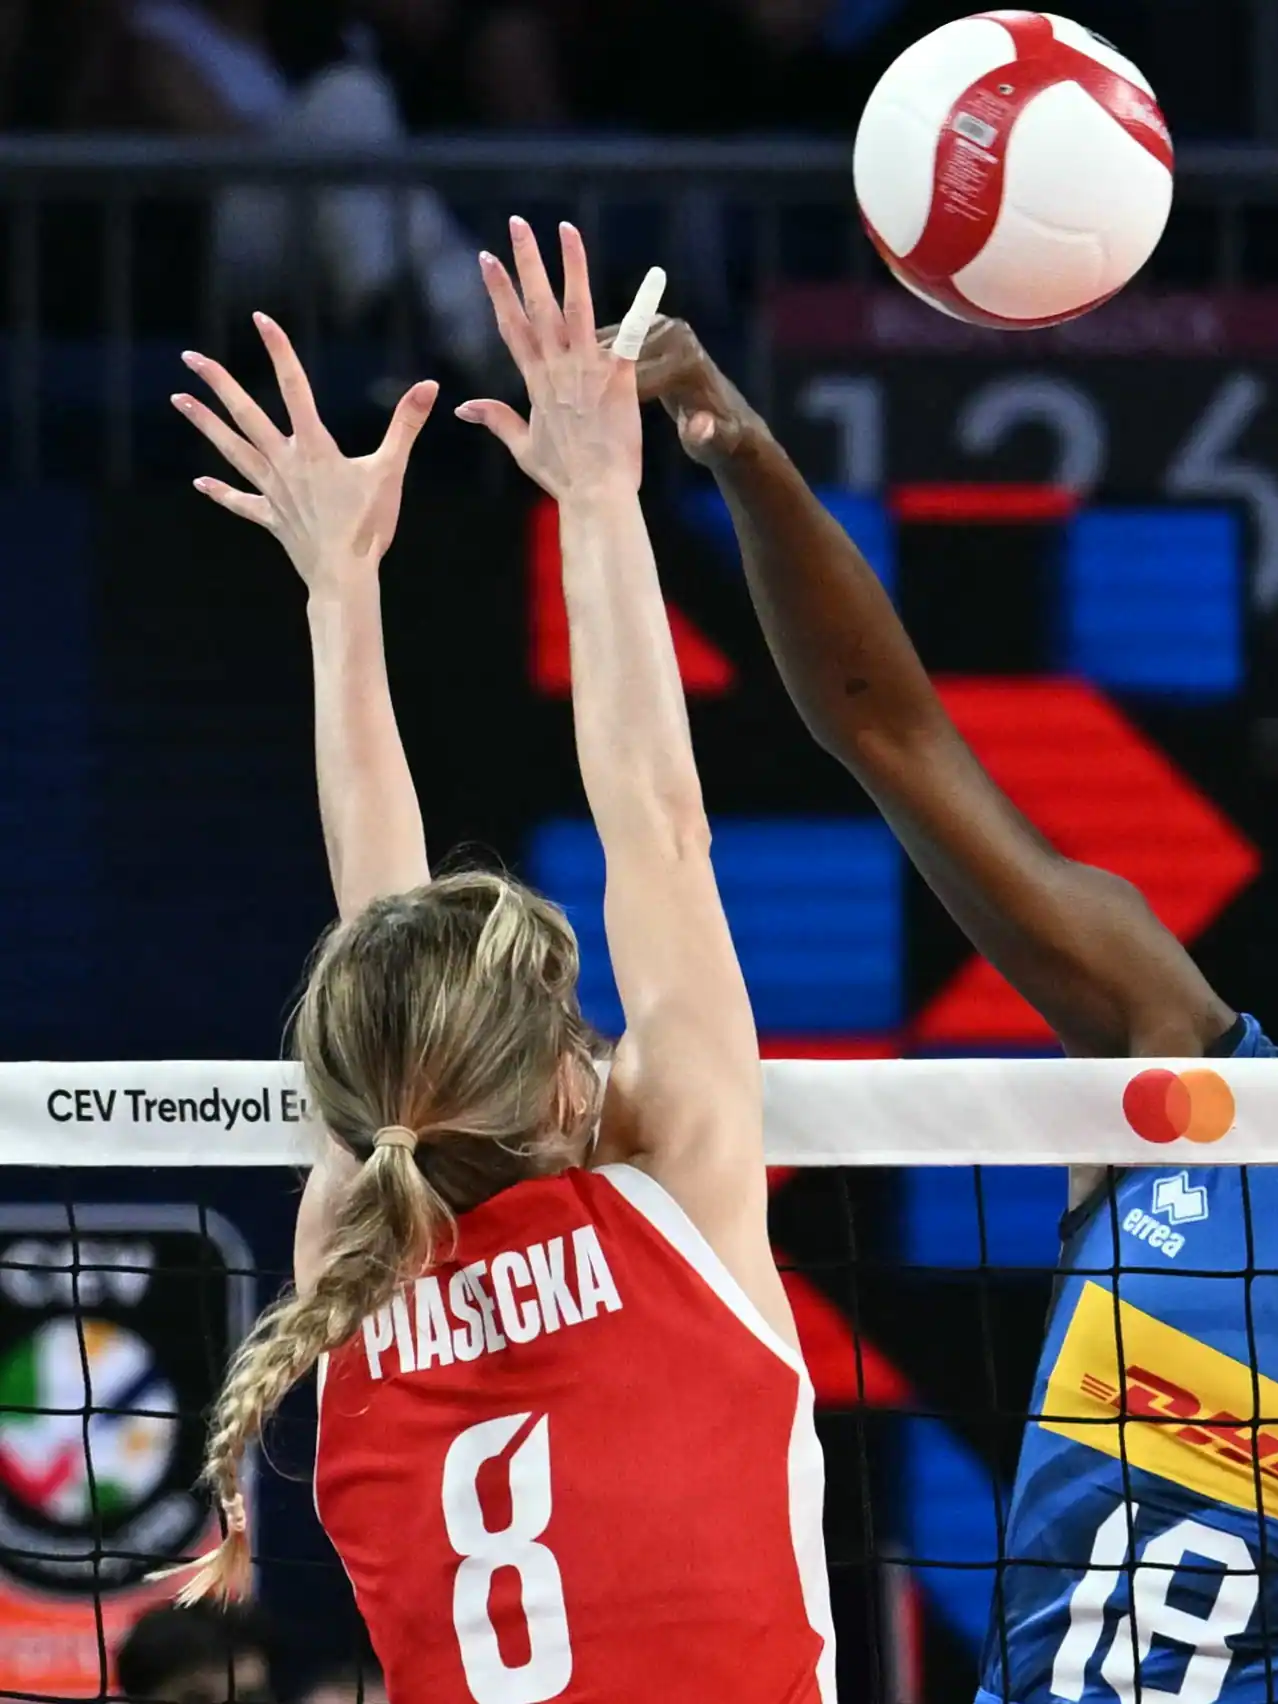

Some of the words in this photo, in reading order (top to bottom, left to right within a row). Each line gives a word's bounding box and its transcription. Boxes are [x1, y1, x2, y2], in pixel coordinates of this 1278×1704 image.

[46, 1088, 117, 1122] CEV
[123, 1086, 271, 1131] Trendyol
[362, 1224, 623, 1380] PIASECKA
[1122, 1208, 1185, 1259] errea
[441, 1411, 573, 1704] 8
[1050, 1500, 1260, 1704] 18
